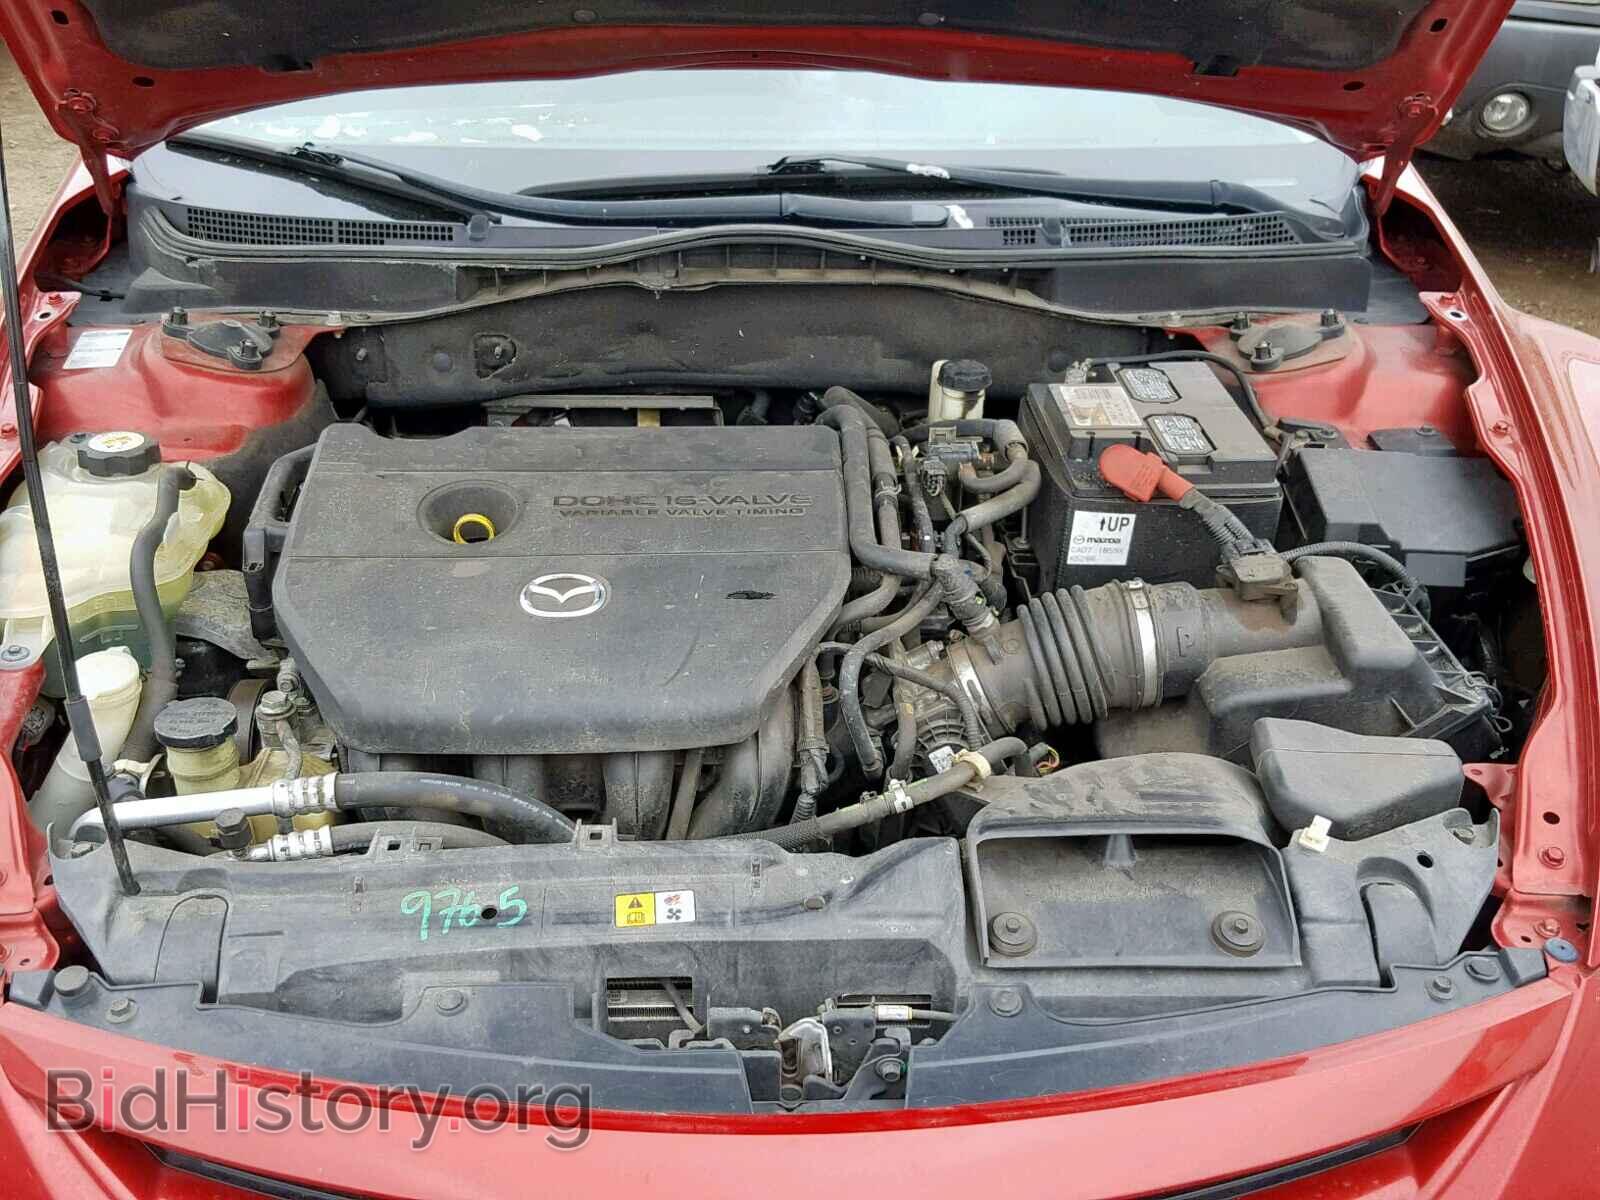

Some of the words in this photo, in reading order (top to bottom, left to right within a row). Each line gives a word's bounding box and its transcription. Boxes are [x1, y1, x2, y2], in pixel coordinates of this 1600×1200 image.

[553, 494, 658, 507] DOHC
[663, 493, 812, 507] 16-VALVE
[559, 508, 658, 518] VARIABLE
[665, 508, 730, 518] VALVE
[736, 508, 805, 517] TIMING
[1107, 516, 1131, 532] UP
[400, 884, 528, 941] 9765
